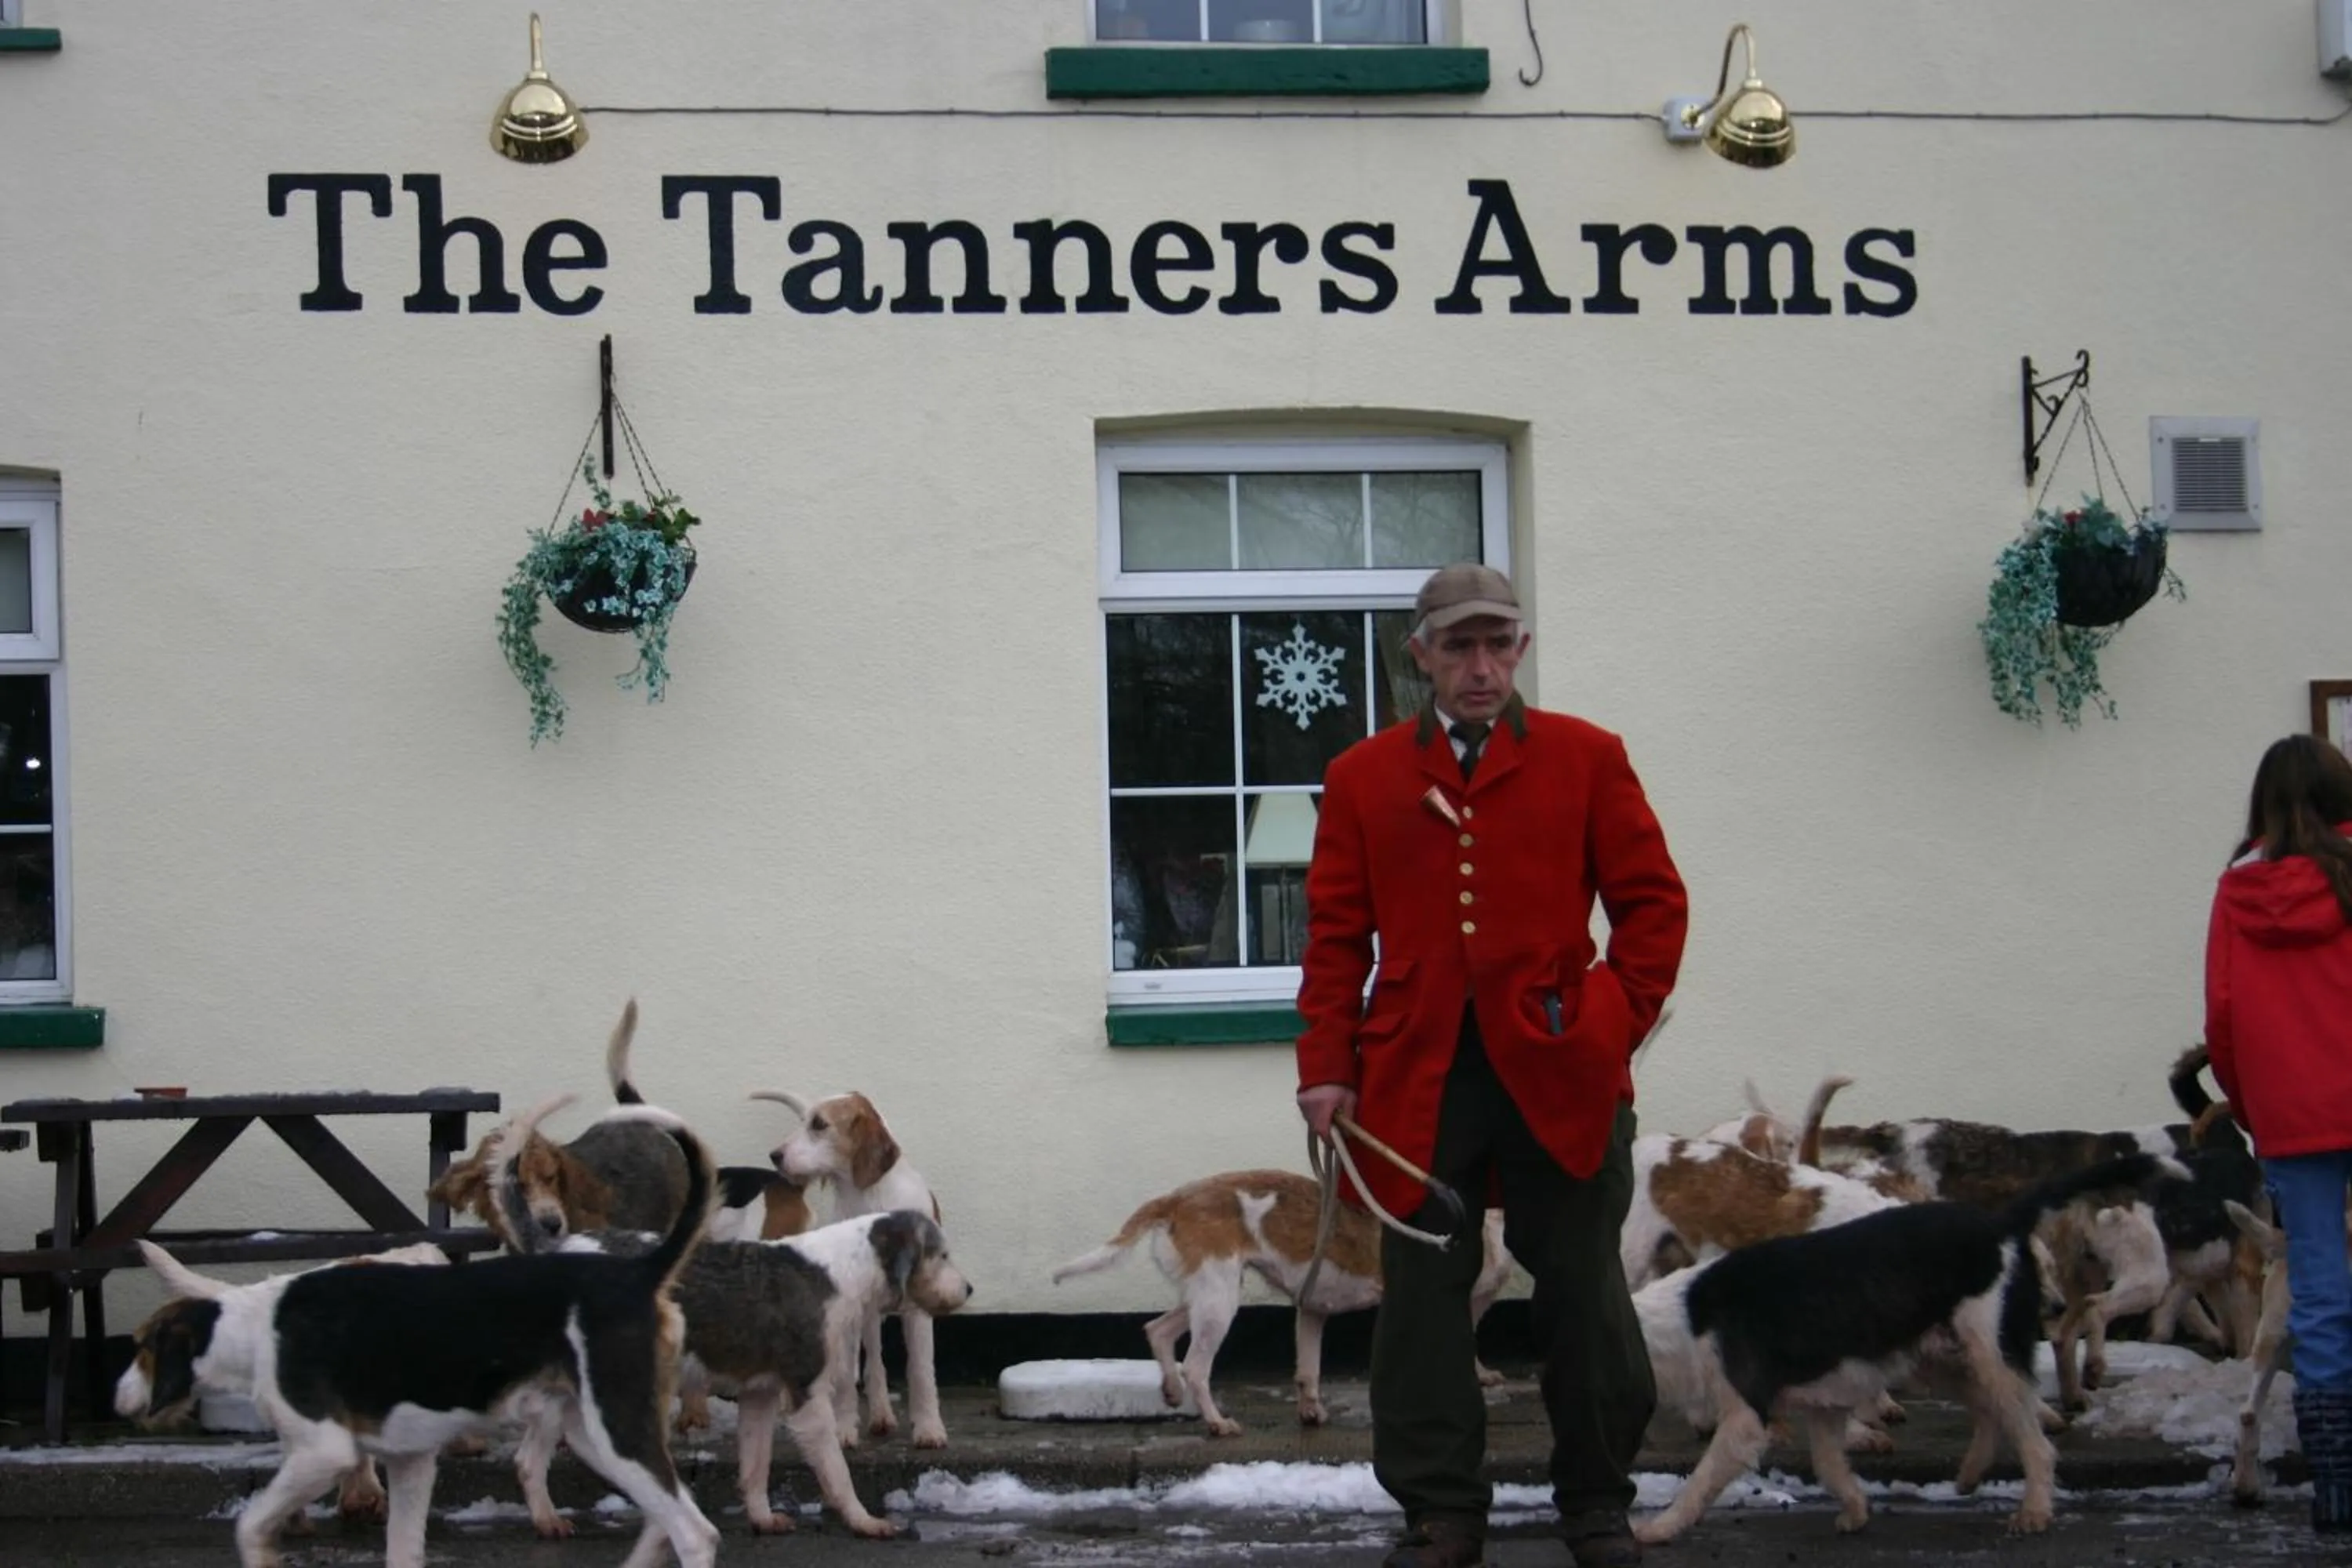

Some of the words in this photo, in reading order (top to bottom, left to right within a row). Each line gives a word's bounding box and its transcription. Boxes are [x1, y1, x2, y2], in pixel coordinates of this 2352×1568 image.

[267, 173, 608, 316] The
[661, 175, 1399, 315] Tanners
[1434, 179, 1918, 318] Arms
